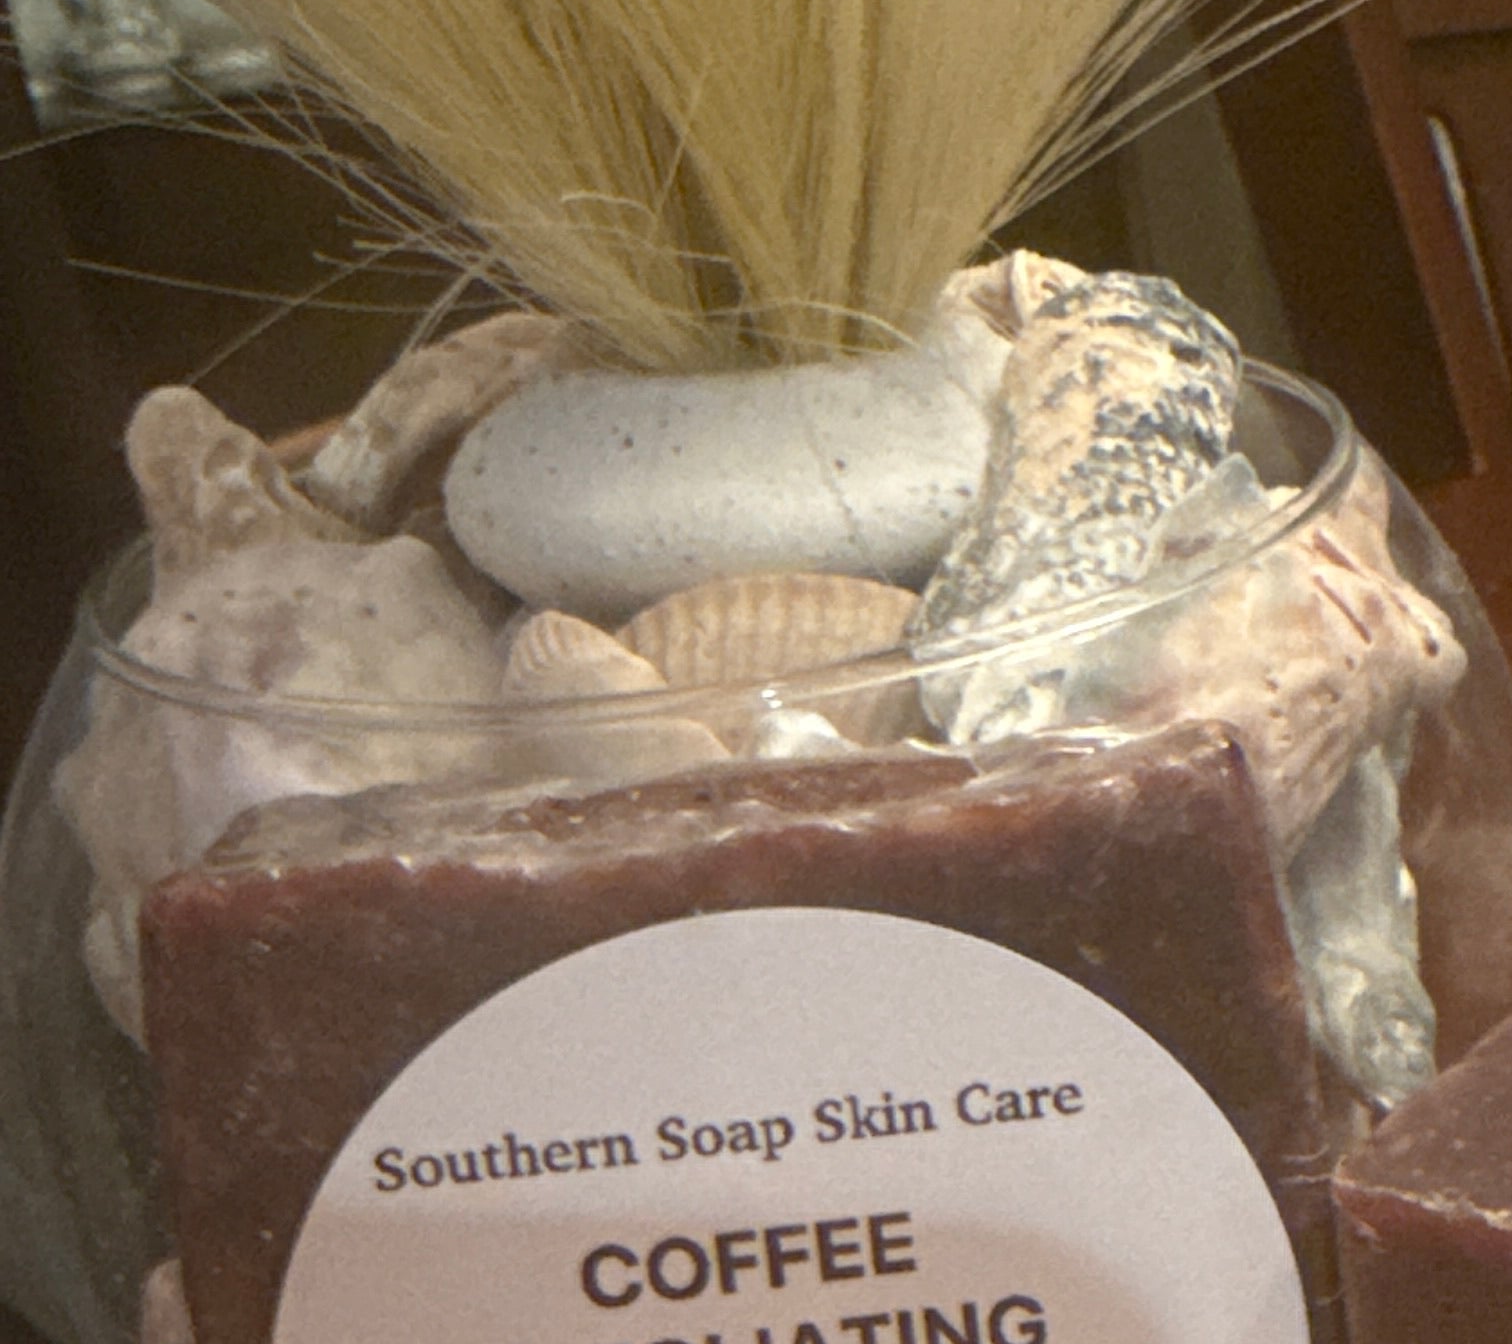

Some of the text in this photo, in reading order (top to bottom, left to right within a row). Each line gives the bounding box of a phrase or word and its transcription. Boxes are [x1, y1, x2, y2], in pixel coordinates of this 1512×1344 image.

[372, 1081, 1084, 1193] Southern Soap Skin Care
[579, 1210, 919, 1310] COFFEE
